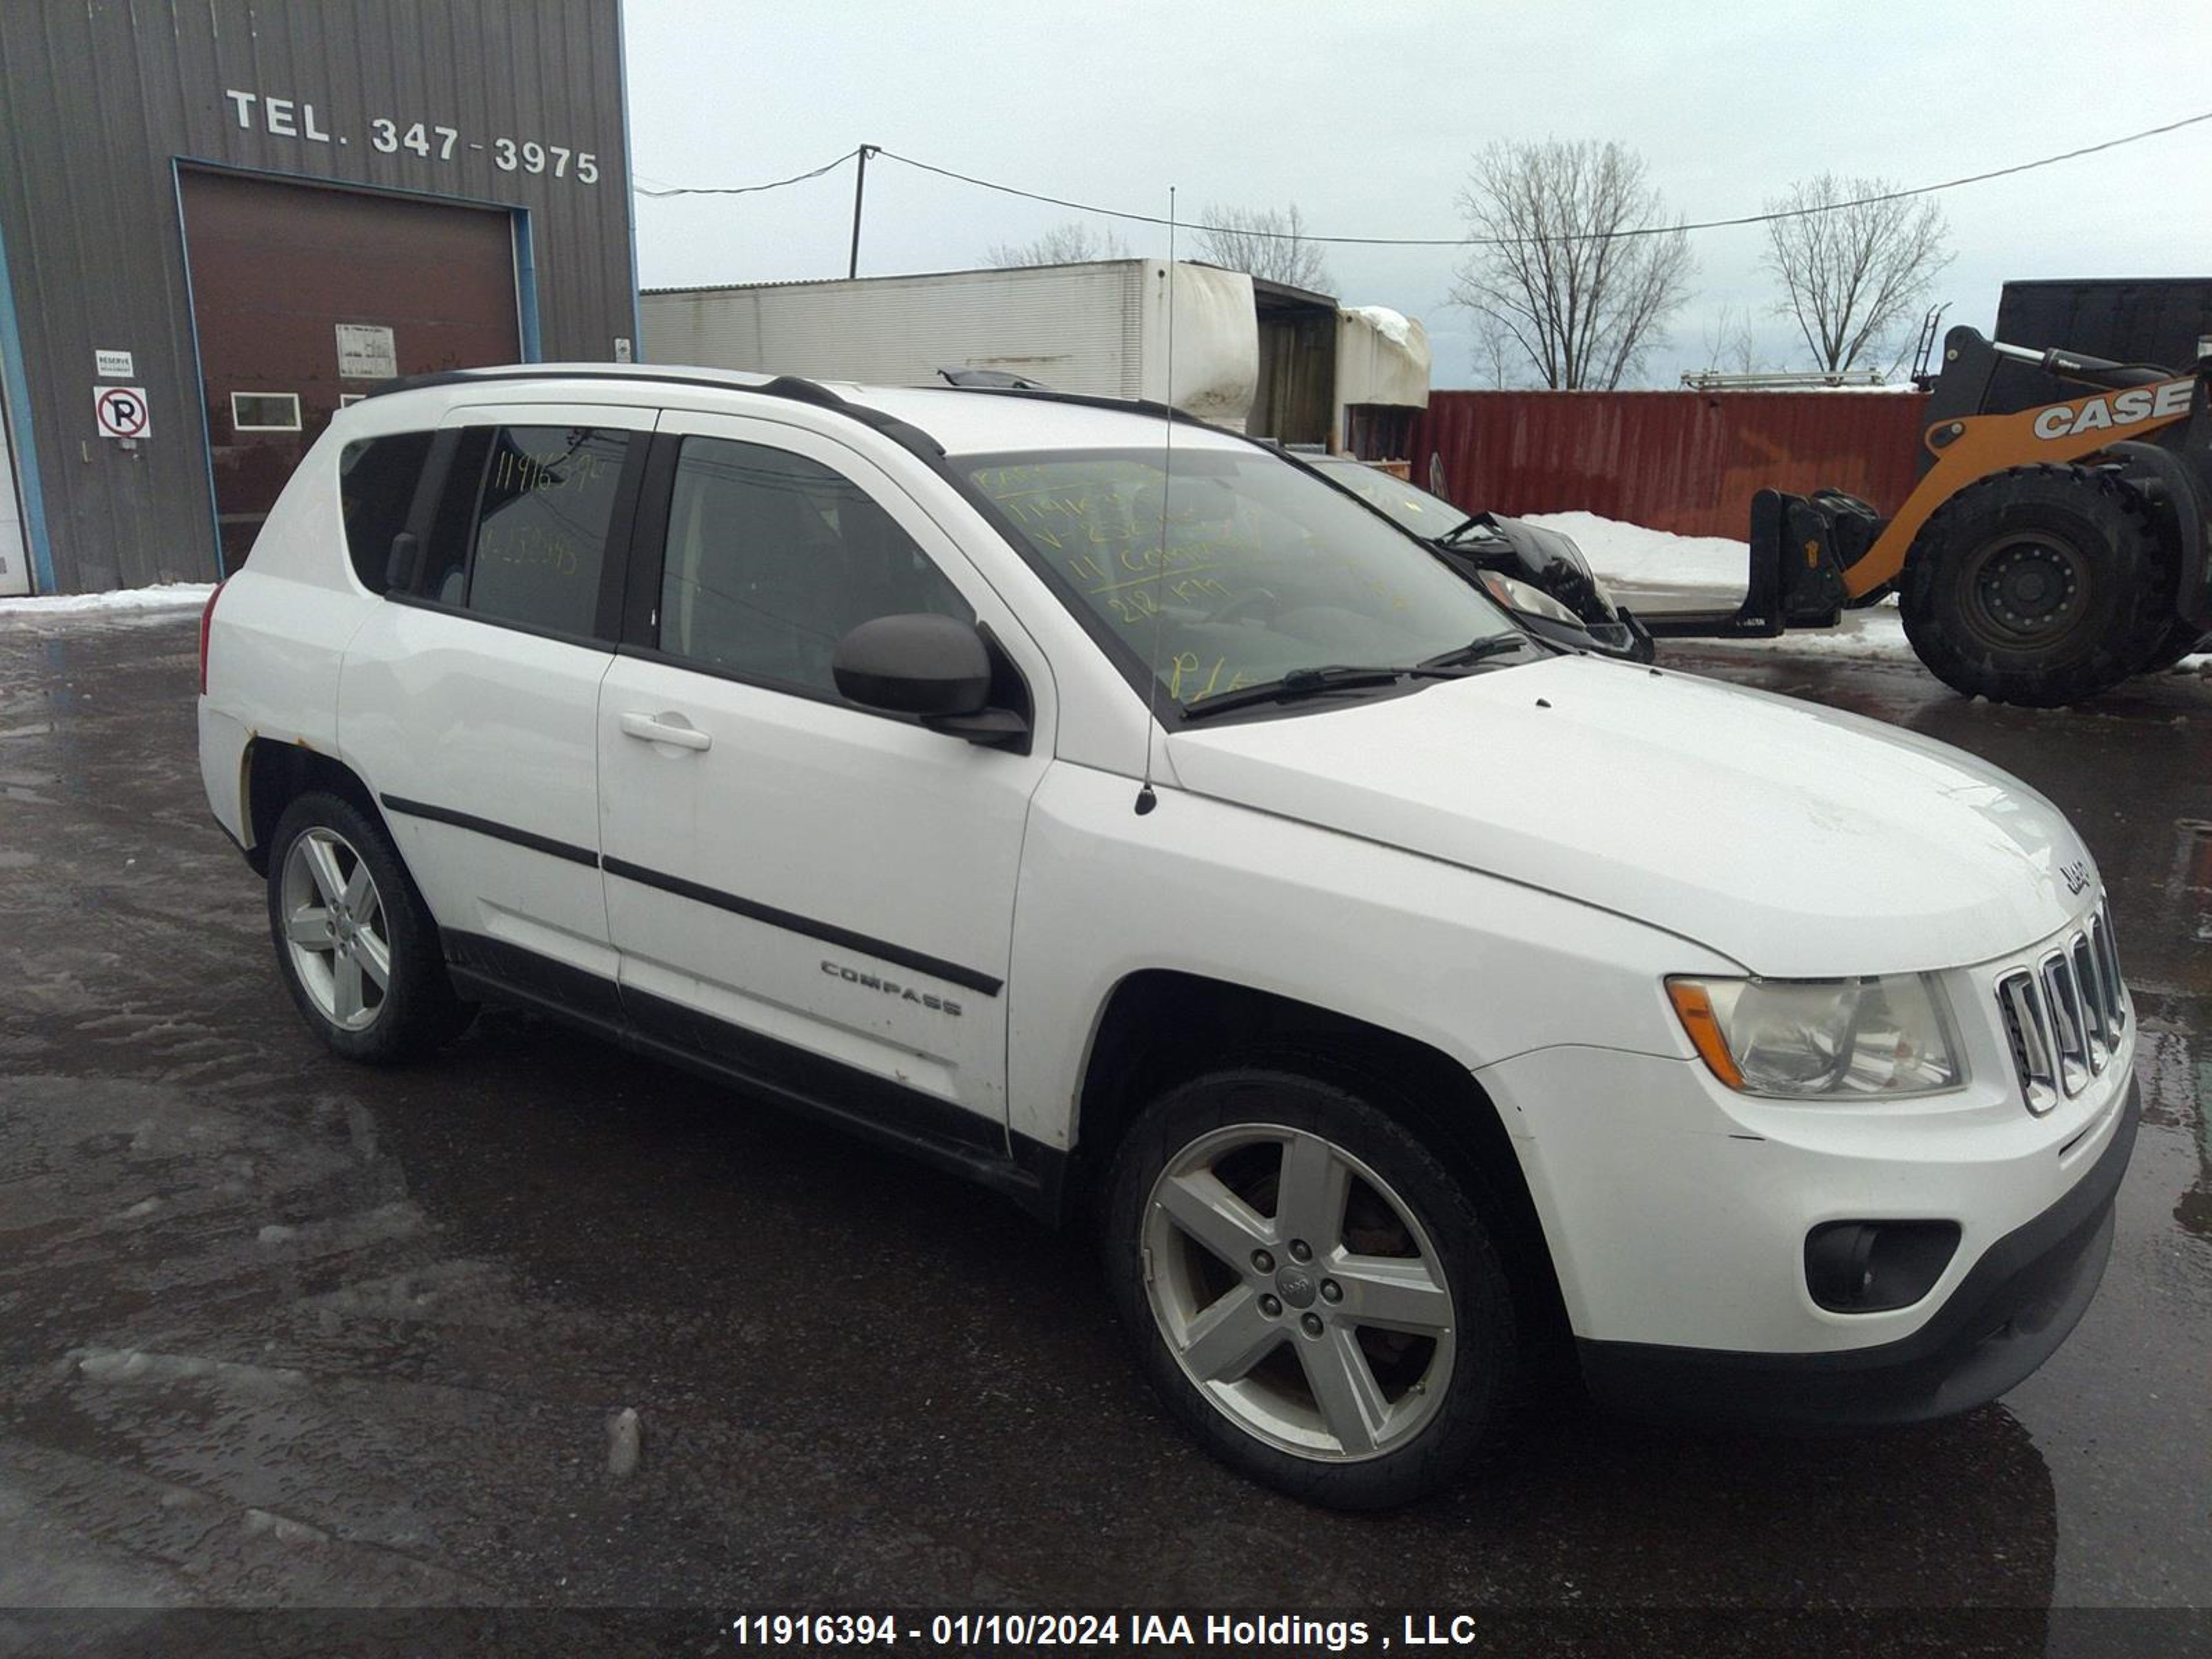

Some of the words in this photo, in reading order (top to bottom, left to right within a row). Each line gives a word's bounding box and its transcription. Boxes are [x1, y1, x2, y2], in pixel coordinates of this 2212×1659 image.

[227, 89, 347, 144] TEL.
[372, 118, 599, 184] 347-3975
[2034, 379, 2195, 440] CASE
[821, 960, 962, 1017] COMPASS
